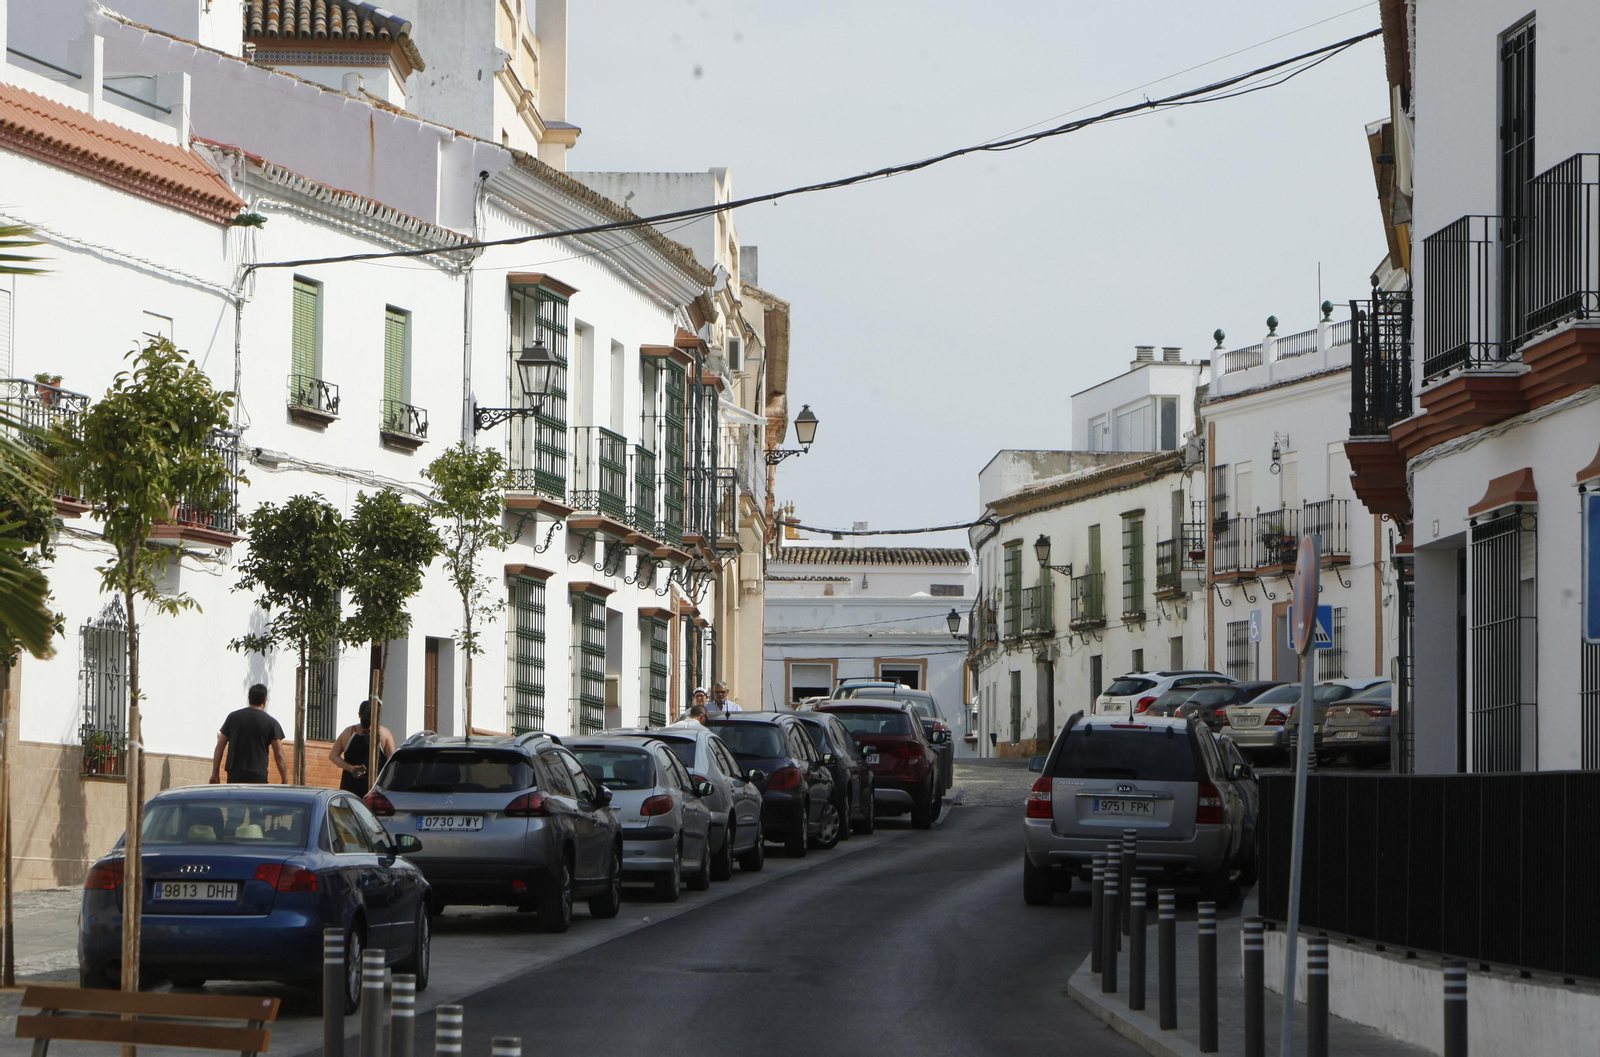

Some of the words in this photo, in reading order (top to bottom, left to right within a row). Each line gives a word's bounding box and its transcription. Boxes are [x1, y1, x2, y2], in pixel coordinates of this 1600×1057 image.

[1101, 801, 1125, 812] 9751
[1130, 801, 1150, 813] FPK
[425, 817, 454, 827] 0730
[458, 817, 480, 827] JWY
[164, 884, 198, 898] 9813
[206, 884, 234, 898] DHH
